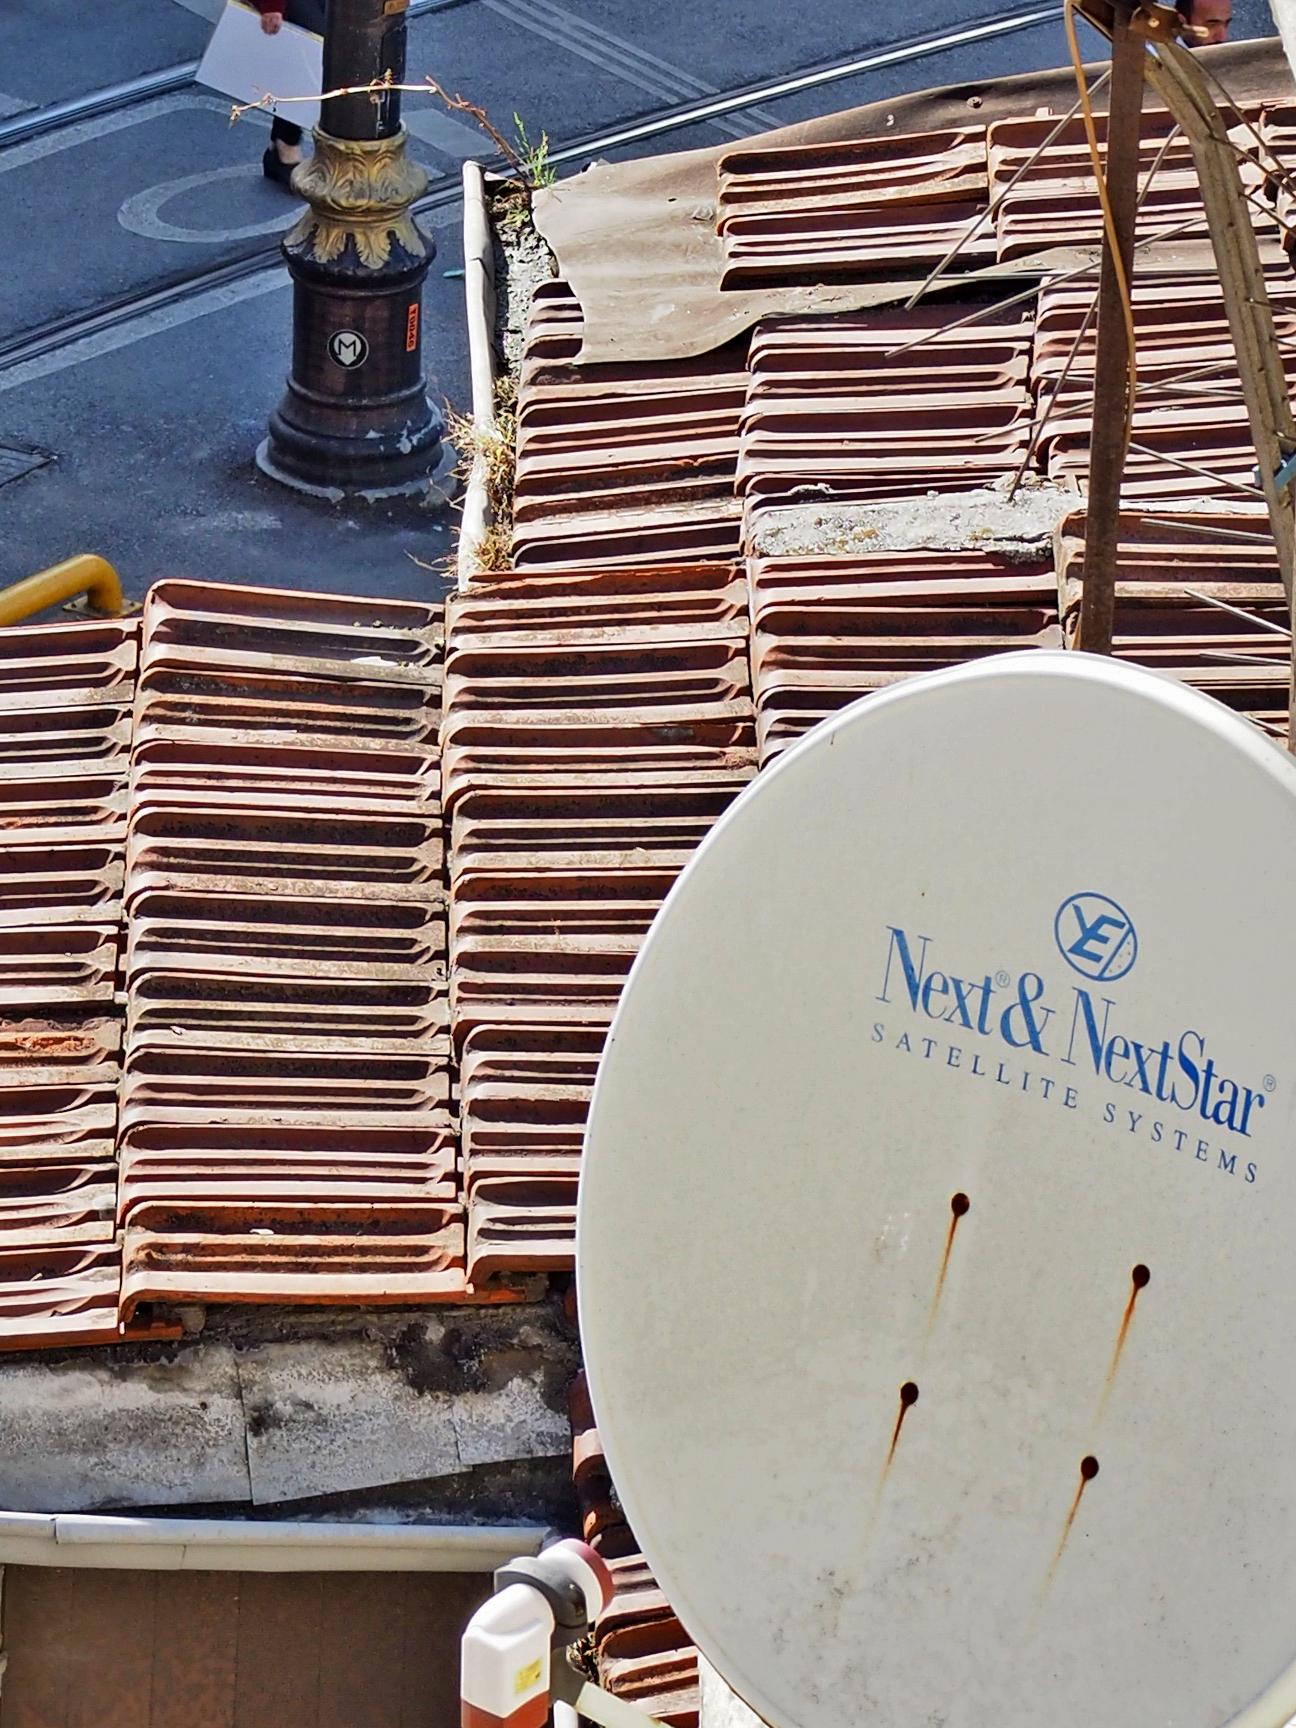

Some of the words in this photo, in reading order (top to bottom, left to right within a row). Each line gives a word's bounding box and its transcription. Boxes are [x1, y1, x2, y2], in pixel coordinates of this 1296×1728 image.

[999, 971, 1056, 1057] &
[871, 1022, 1079, 1109] SATELLITE
[1102, 1103, 1258, 1184] SYSTEMS
